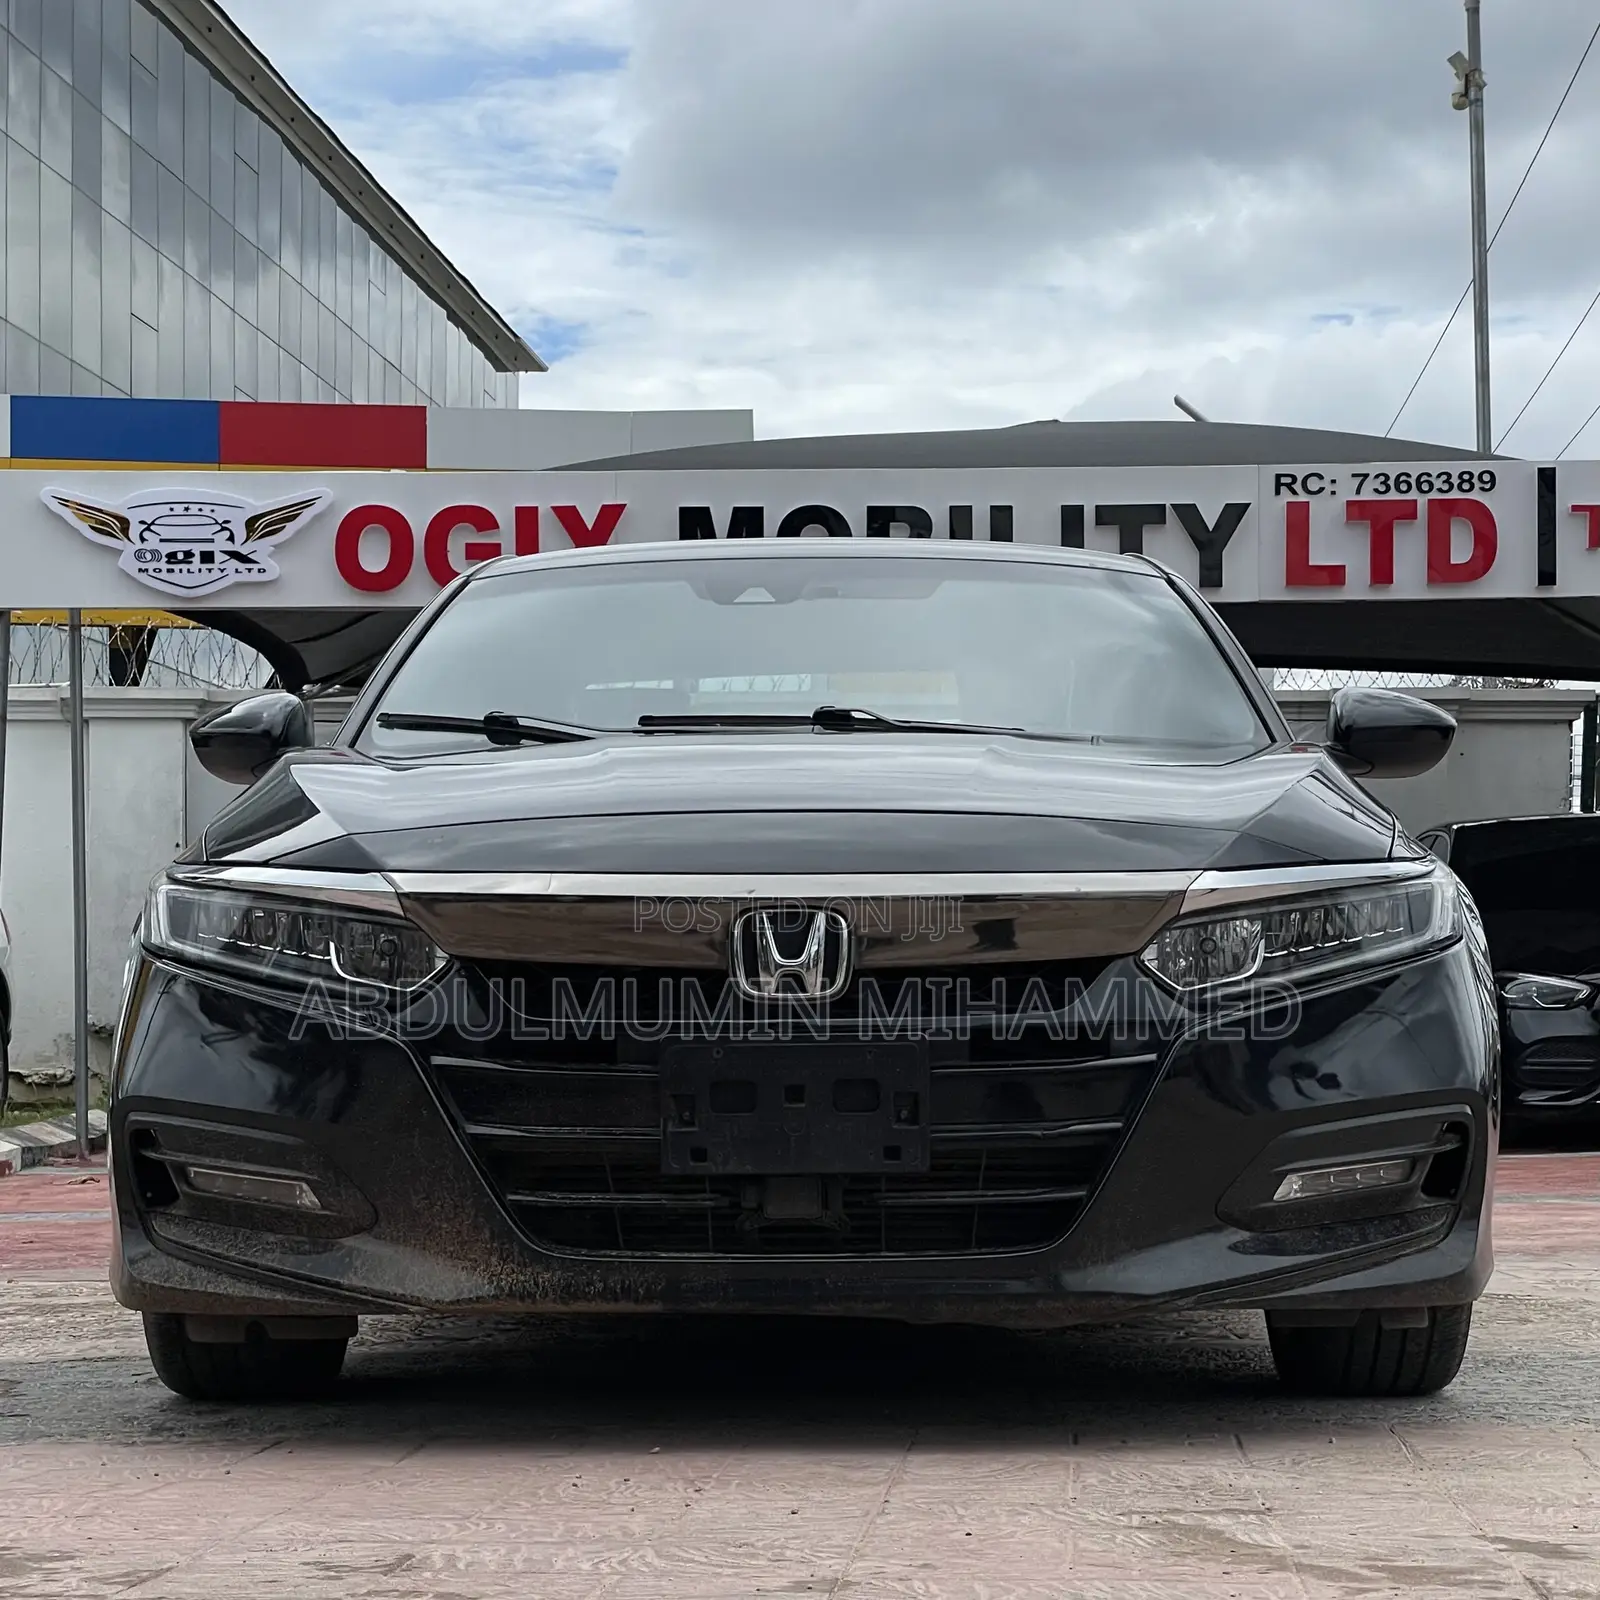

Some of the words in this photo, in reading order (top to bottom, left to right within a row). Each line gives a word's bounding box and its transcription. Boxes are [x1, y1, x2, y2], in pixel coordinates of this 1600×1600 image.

[1274, 473, 1337, 496] RC:
[1350, 470, 1497, 494] 7366389
[1285, 497, 1498, 586] LTD
